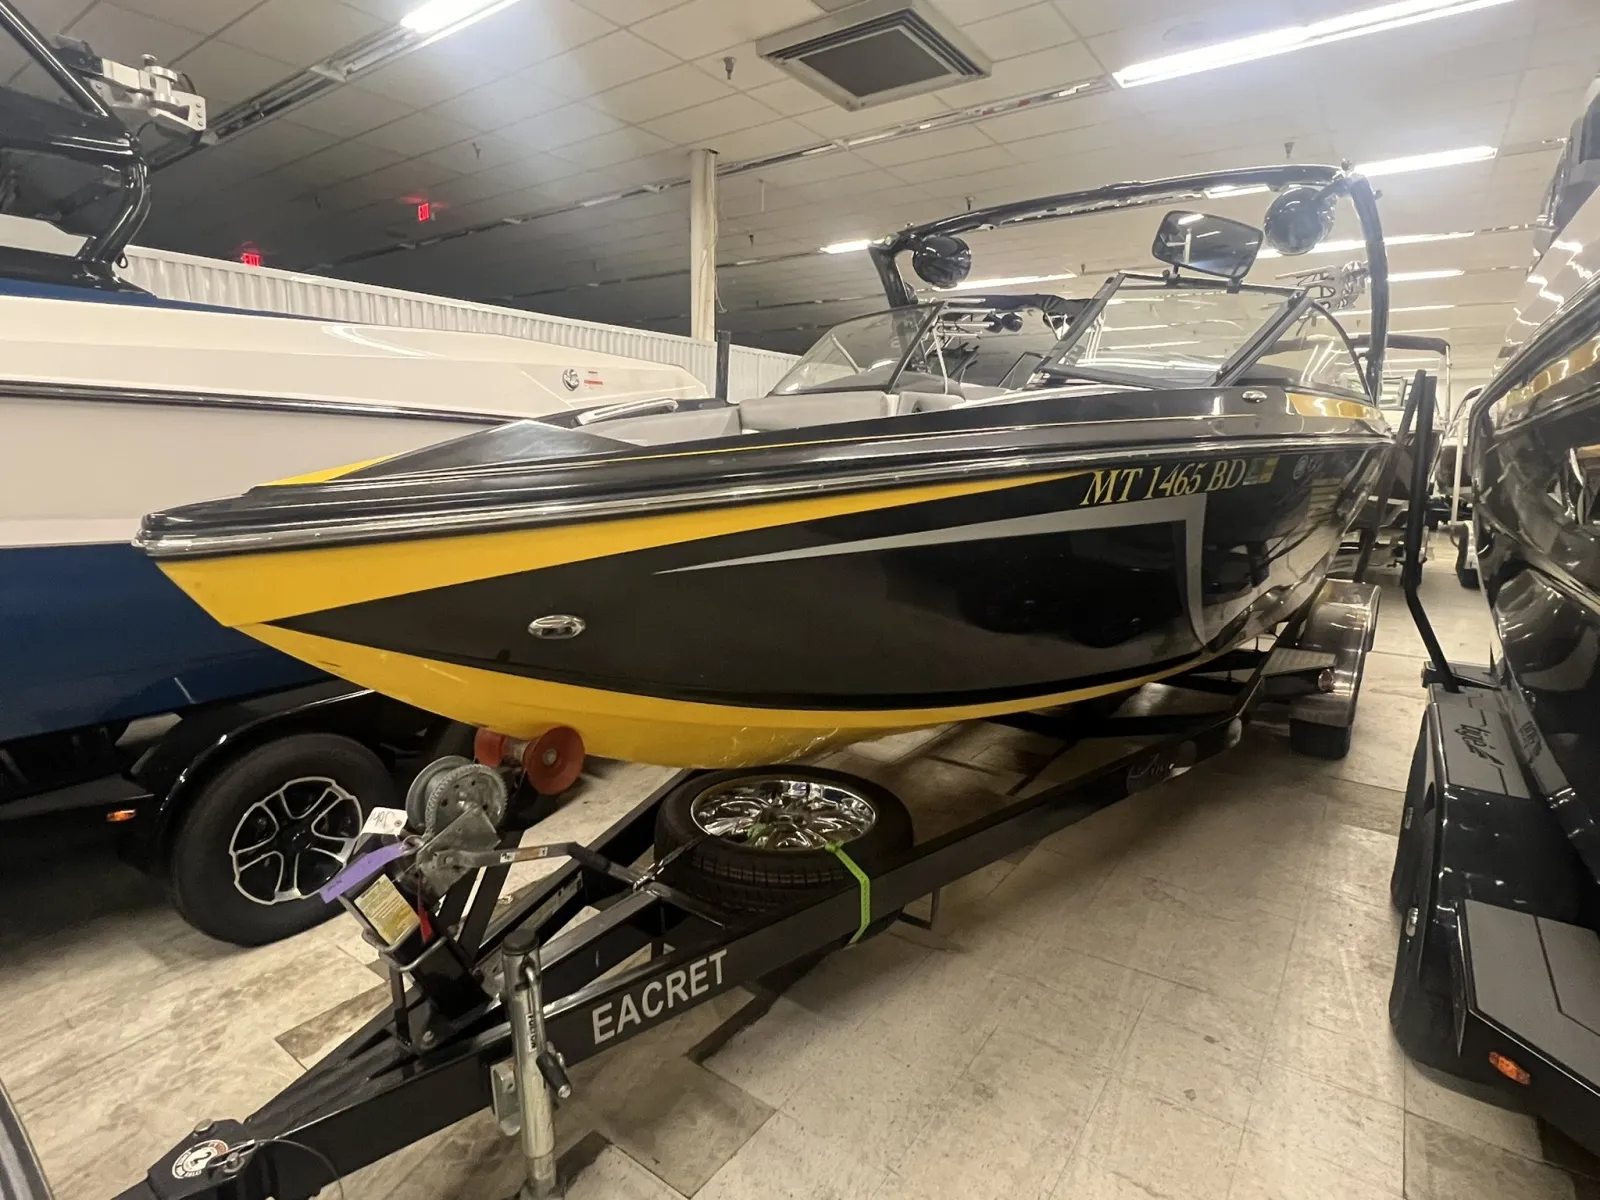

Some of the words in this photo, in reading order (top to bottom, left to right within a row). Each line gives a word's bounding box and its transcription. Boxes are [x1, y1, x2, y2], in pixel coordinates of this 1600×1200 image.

[418, 203, 429, 221] EXIT
[244, 253, 260, 266] EXIT
[1079, 468, 1144, 506] MT
[1144, 462, 1207, 499] 1465
[1205, 459, 1247, 491] BD
[592, 949, 728, 1045] EACRET
